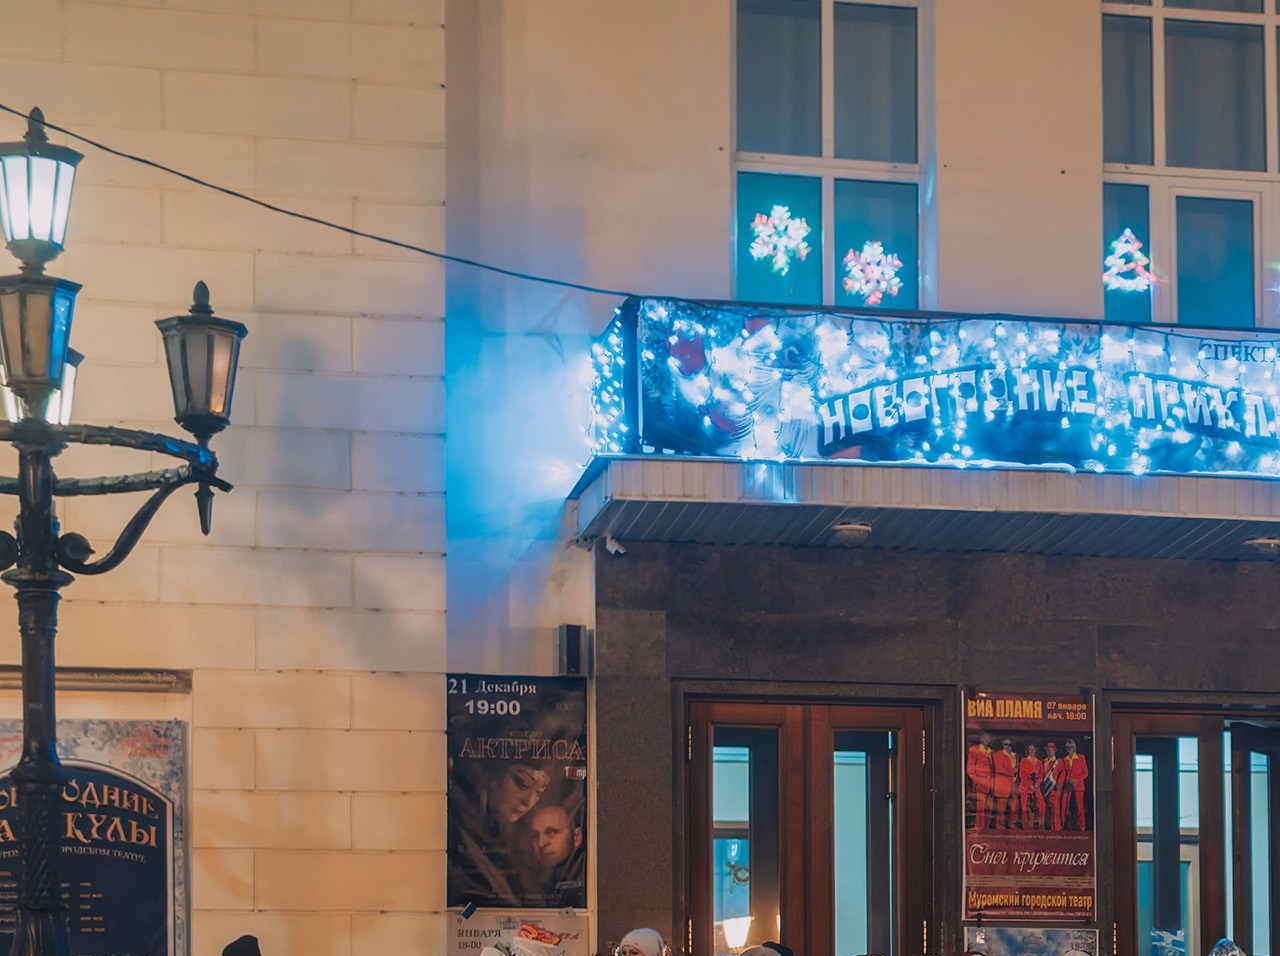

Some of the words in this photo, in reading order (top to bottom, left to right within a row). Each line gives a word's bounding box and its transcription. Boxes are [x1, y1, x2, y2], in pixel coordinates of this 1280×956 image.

[820, 369, 1097, 446] НОВОГОДНИЕ
[448, 679, 467, 694] 21
[475, 680, 537, 696] Декабря
[465, 699, 520, 715] 19:00
[967, 699, 994, 718] ВИА
[995, 699, 1043, 719] ПЛАМЯ
[1046, 701, 1057, 710] 07
[1058, 703, 1087, 711] января
[1066, 711, 1087, 720] 18:00
[459, 738, 586, 760] АКТРИСА
[970, 843, 1008, 864] Снег
[1013, 851, 1089, 873] кружится
[968, 891, 1020, 909] Муромский
[1021, 892, 1067, 909] городской
[1069, 895, 1093, 910] театр
[457, 928, 501, 938] ЯНВАРЯ
